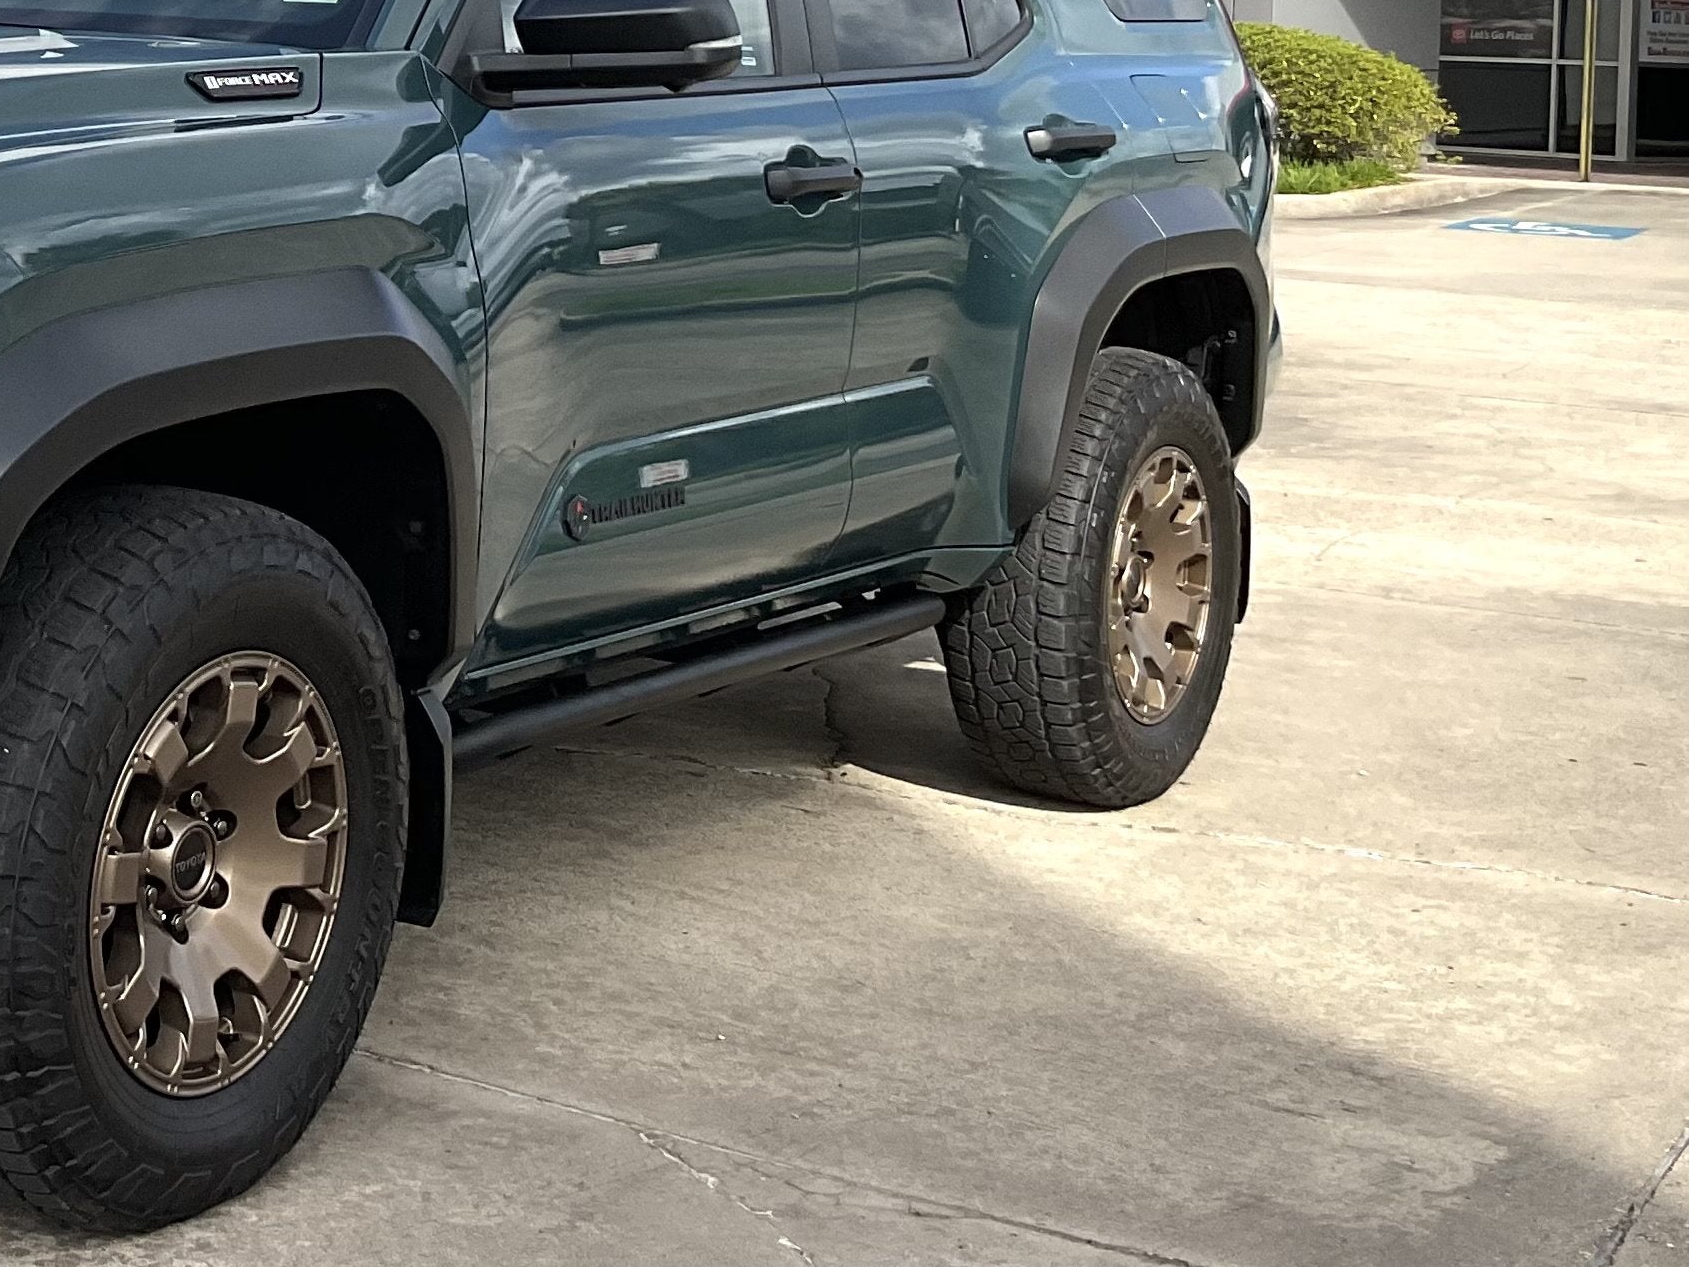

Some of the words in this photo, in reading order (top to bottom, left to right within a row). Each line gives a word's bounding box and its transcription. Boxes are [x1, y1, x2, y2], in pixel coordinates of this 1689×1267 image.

[1491, 30, 1505, 40] Go
[251, 72, 299, 85] MAX
[176, 851, 207, 873] TOYOTA
